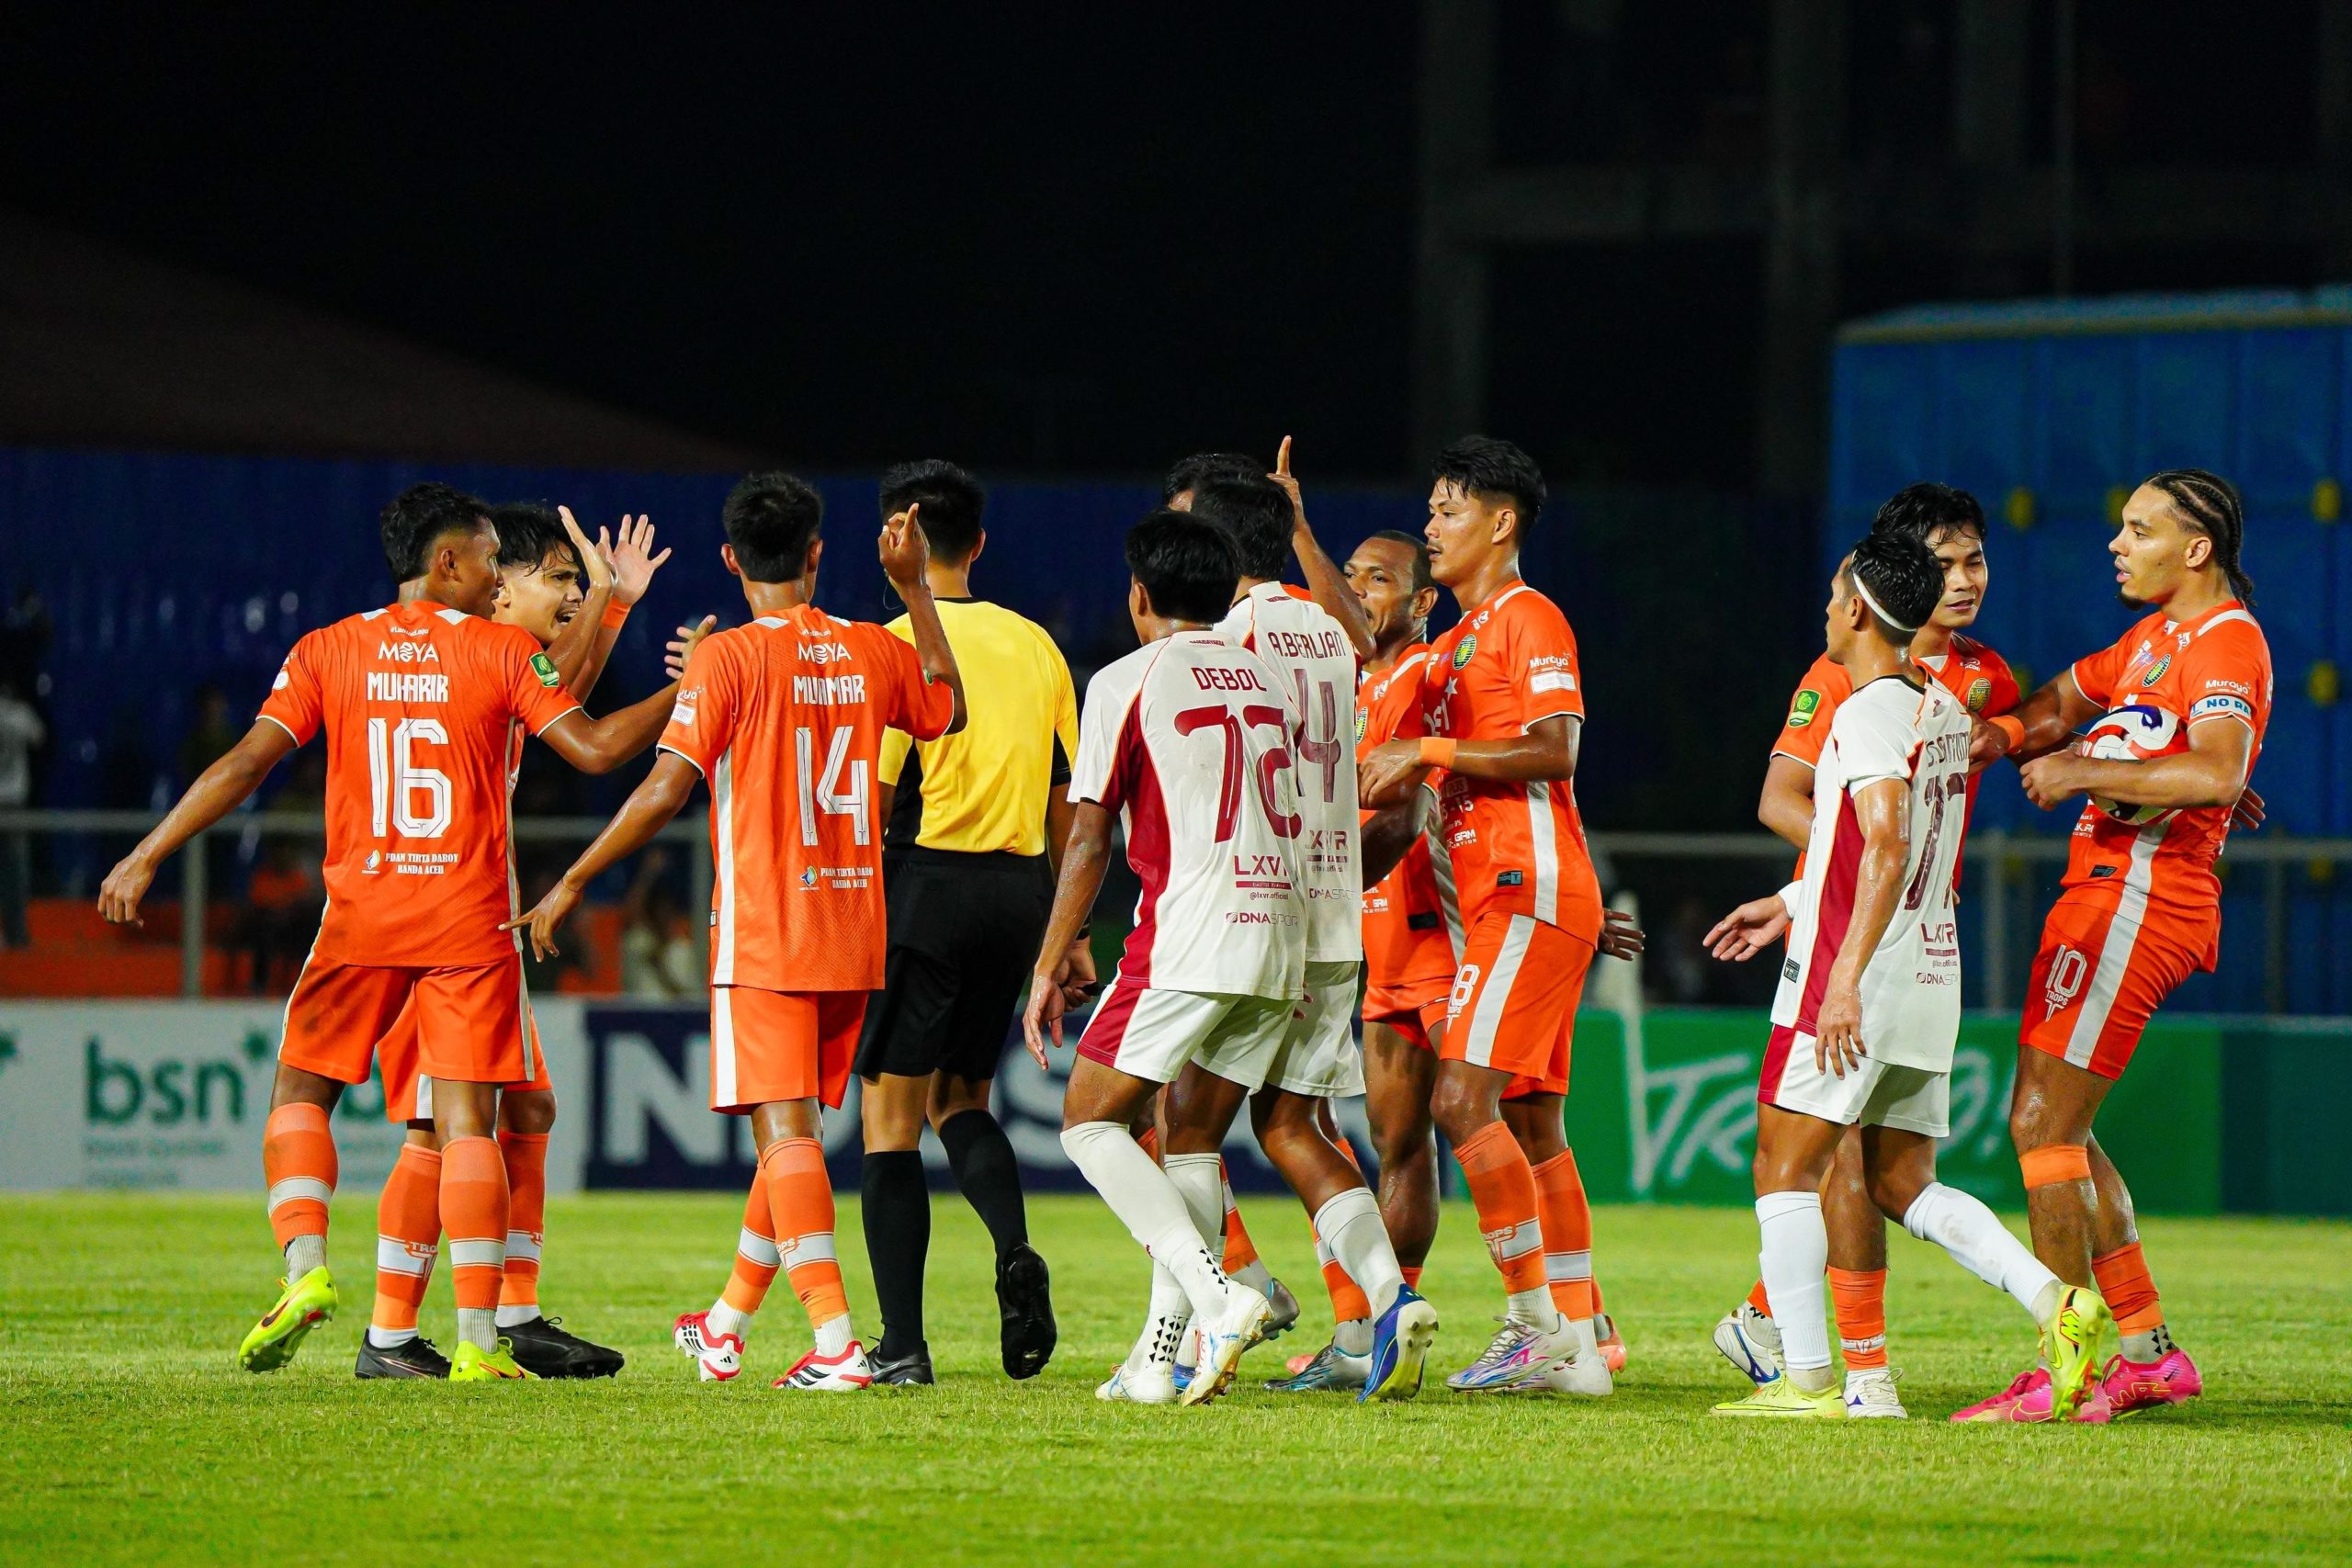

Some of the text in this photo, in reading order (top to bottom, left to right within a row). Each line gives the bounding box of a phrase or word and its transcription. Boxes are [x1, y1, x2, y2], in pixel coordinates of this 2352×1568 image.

[1268, 630, 1346, 659] A.BERLIAN
[1191, 667, 1267, 692] DEBOL
[2207, 698, 2251, 716] NO RA
[1294, 668, 1341, 804] 4
[368, 717, 452, 838] 16
[796, 725, 870, 846] 14
[1174, 704, 1303, 843] 72
[424, 864, 445, 874] ACEH
[431, 853, 458, 863] DAROY
[1234, 855, 1288, 877] LXV
[2045, 943, 2087, 998] 10
[2046, 989, 2068, 1006] TROPS
[84, 1034, 246, 1125] bsn
[410, 1241, 437, 1253] TRO
